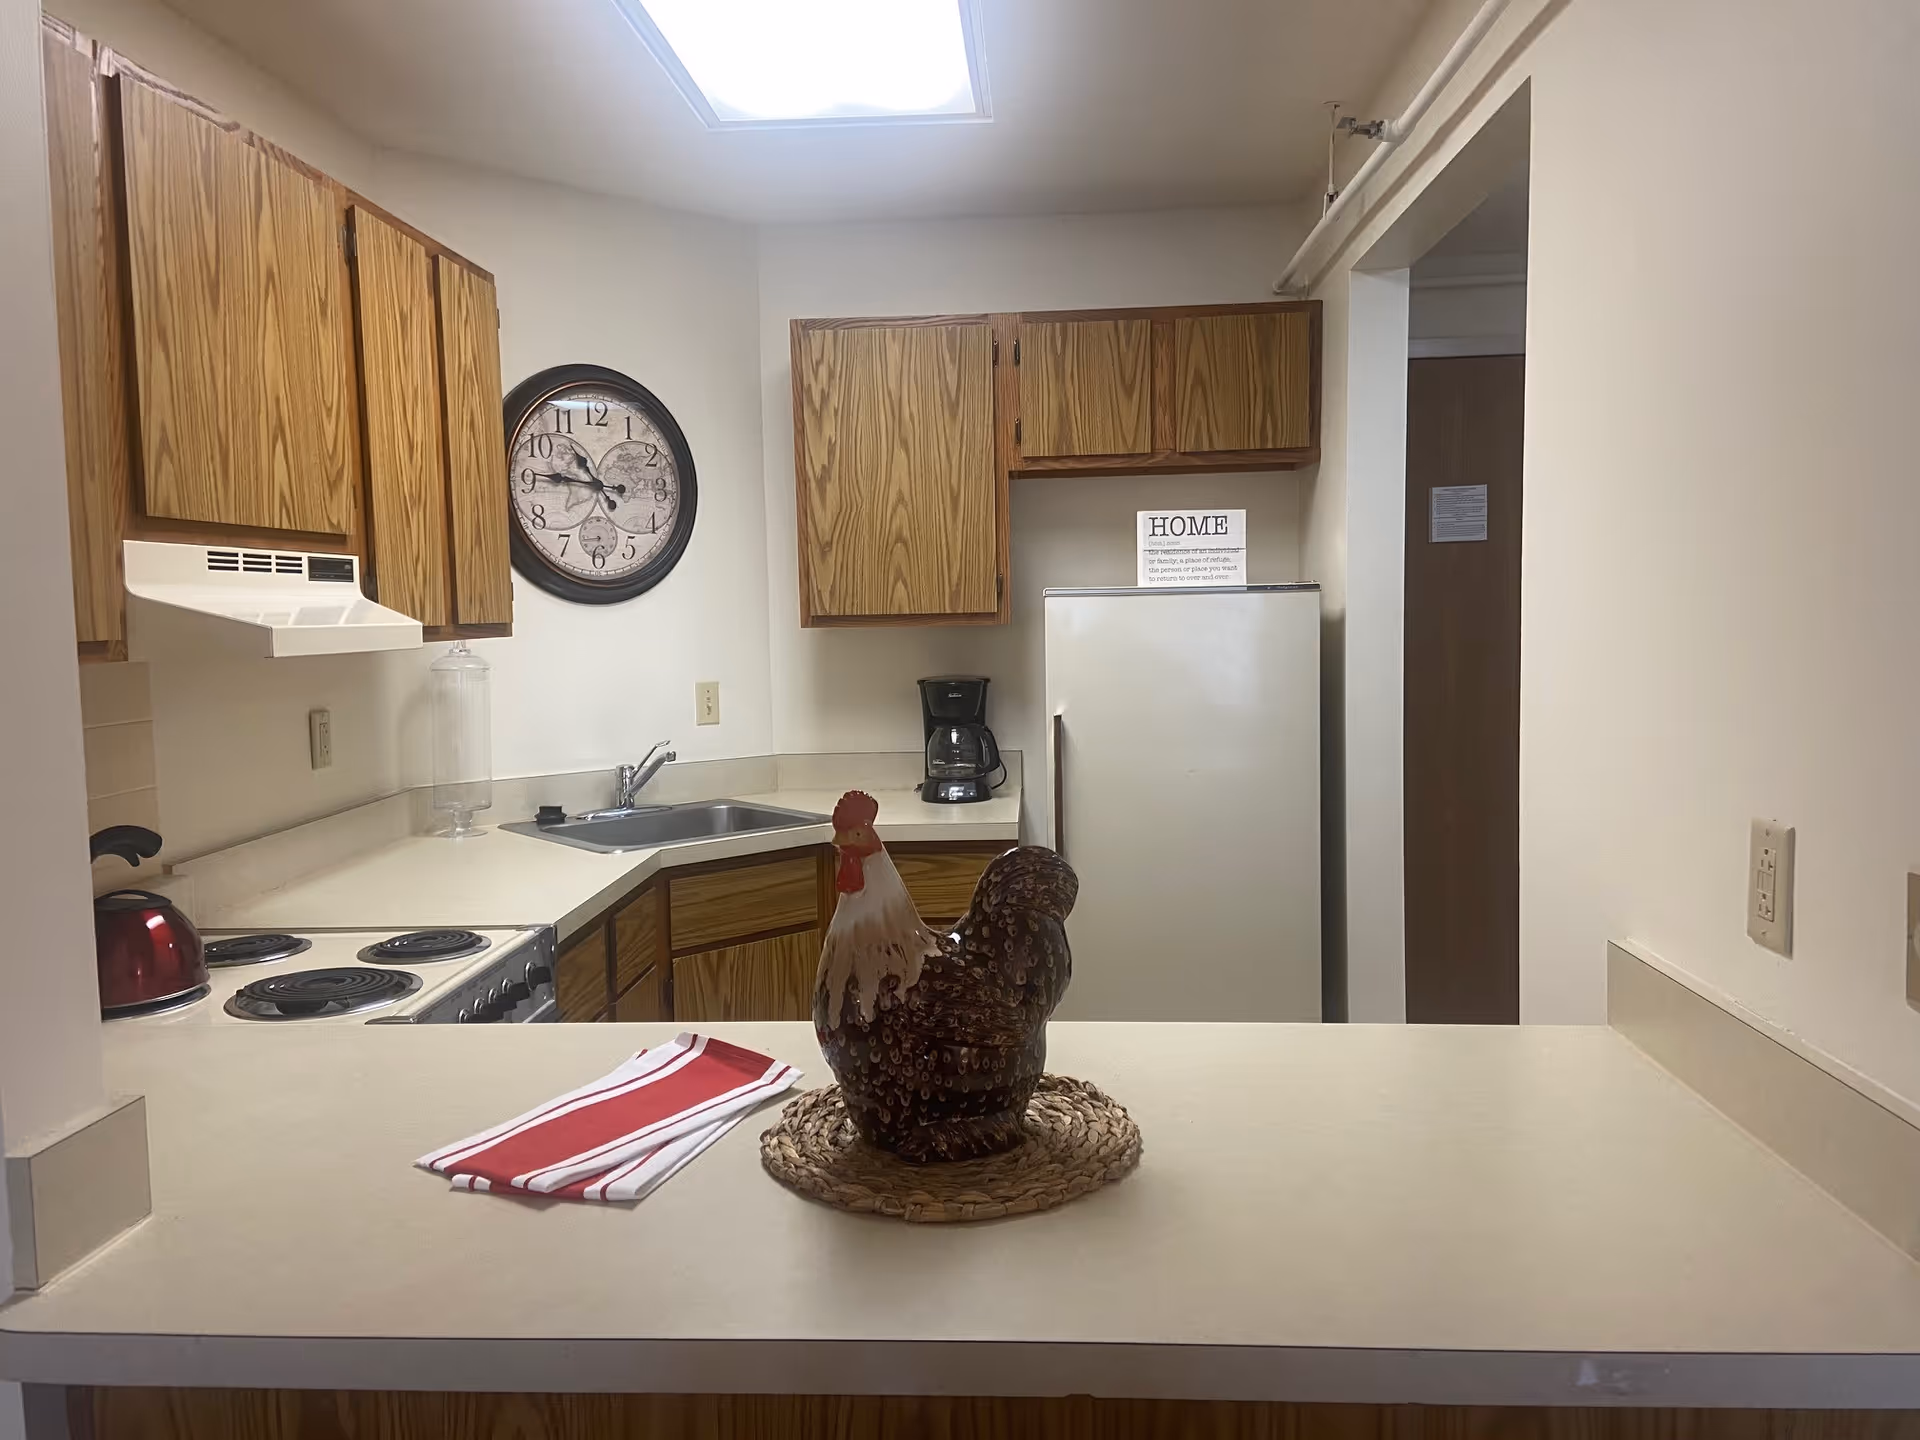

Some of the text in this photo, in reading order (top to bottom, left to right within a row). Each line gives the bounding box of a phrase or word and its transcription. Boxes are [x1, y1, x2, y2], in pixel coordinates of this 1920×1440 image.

[554, 408, 574, 434] 11
[585, 400, 609, 427] 12
[624, 415, 632, 440] 1
[528, 433, 553, 460] 10
[644, 443, 658, 468] 2
[520, 468, 536, 494] 9
[654, 478, 667, 502] 3
[531, 503, 546, 530] 8
[645, 511, 657, 534] 4
[1148, 515, 1228, 537] HOME
[557, 533, 571, 558] 7
[591, 545, 606, 570] 6
[622, 535, 636, 560] 5
